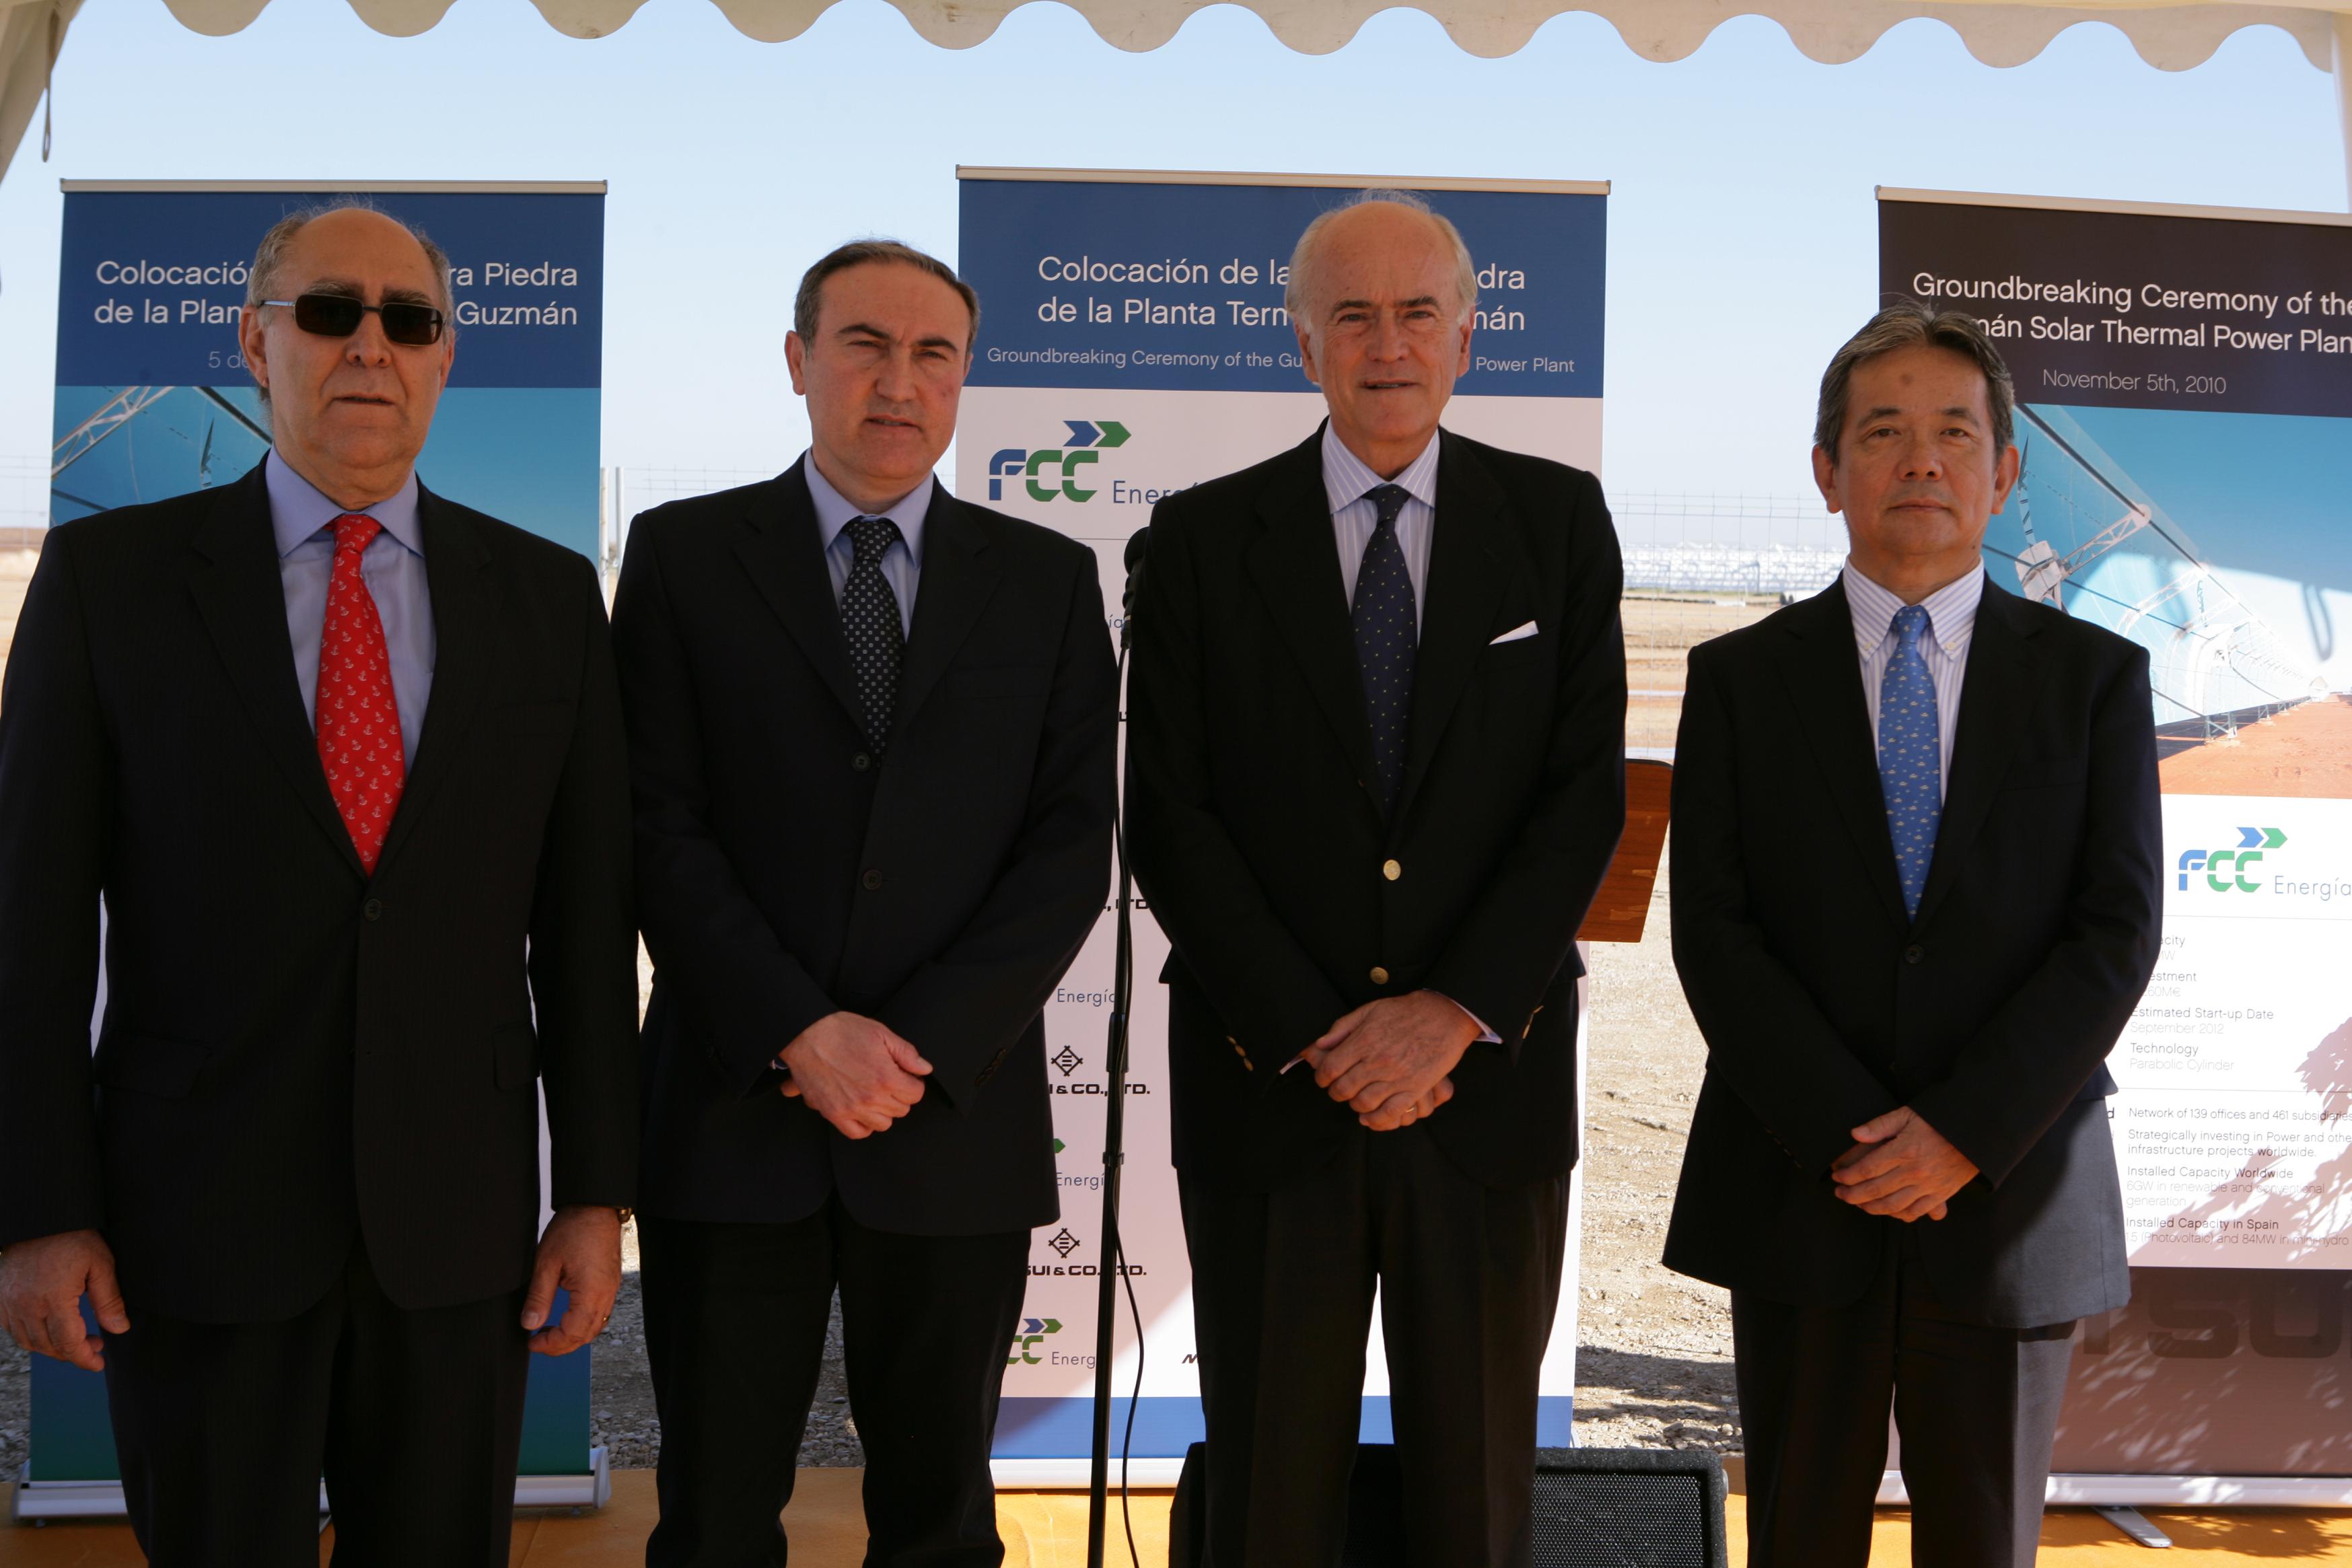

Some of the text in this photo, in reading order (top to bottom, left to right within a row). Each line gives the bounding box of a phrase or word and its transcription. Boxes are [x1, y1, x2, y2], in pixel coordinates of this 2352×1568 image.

[96, 260, 254, 285] Colocació
[485, 261, 578, 287] Piedra
[1038, 255, 1525, 289] Colocación de la dra
[1913, 272, 2132, 313] Groundbreaking
[2141, 283, 2279, 319] Ceremony
[2286, 290, 2313, 315] of
[94, 299, 578, 326] de la Plan Guzmán
[1038, 295, 1077, 322] de
[1088, 296, 1112, 323] la
[1125, 297, 1216, 325] Planta
[2030, 315, 2095, 342] Solar
[2100, 318, 2205, 347] Thermal
[2213, 324, 2293, 351] Power
[2300, 328, 2352, 354] Plan
[207, 351, 221, 369] 5
[987, 347, 1575, 372] Groundbreaking Ceremony of the Gu Power Plant
[2043, 369, 2227, 394] November 5th, 2010
[989, 449, 1099, 503] FCC
[2178, 849, 2352, 901] FCC Energía
[2149, 971, 2197, 982] estment
[2131, 1006, 2275, 1022] Estimated Start-up Date
[2129, 1021, 2225, 1035] September 2012
[2130, 1042, 2199, 1057] Technology
[2129, 1057, 2235, 1073] Parabolic Cylinder
[2129, 1107, 2174, 1118] Network
[2176, 1108, 2188, 1118] of
[2190, 1108, 2208, 1118] 139
[2210, 1108, 2246, 1120] offices
[2248, 1109, 2270, 1120] and
[2272, 1110, 2289, 1120] 461
[2128, 1129, 2352, 1145] Strategically investing in Power and othe
[2127, 1144, 2317, 1158] infrastructure projects worldwide.
[2127, 1166, 2293, 1180] Installed Capacity Worldwide
[2127, 1180, 2325, 1194] 6GW in renewable and conventional
[2125, 1196, 2187, 1209] generation
[2126, 1217, 2279, 1232] Installed Capacity in Spain
[2141, 1232, 2213, 1244] (Photovoltaic)
[2217, 1233, 2239, 1244] and
[2242, 1234, 2277, 1244] 84MW
[2279, 1234, 2289, 1244] in
